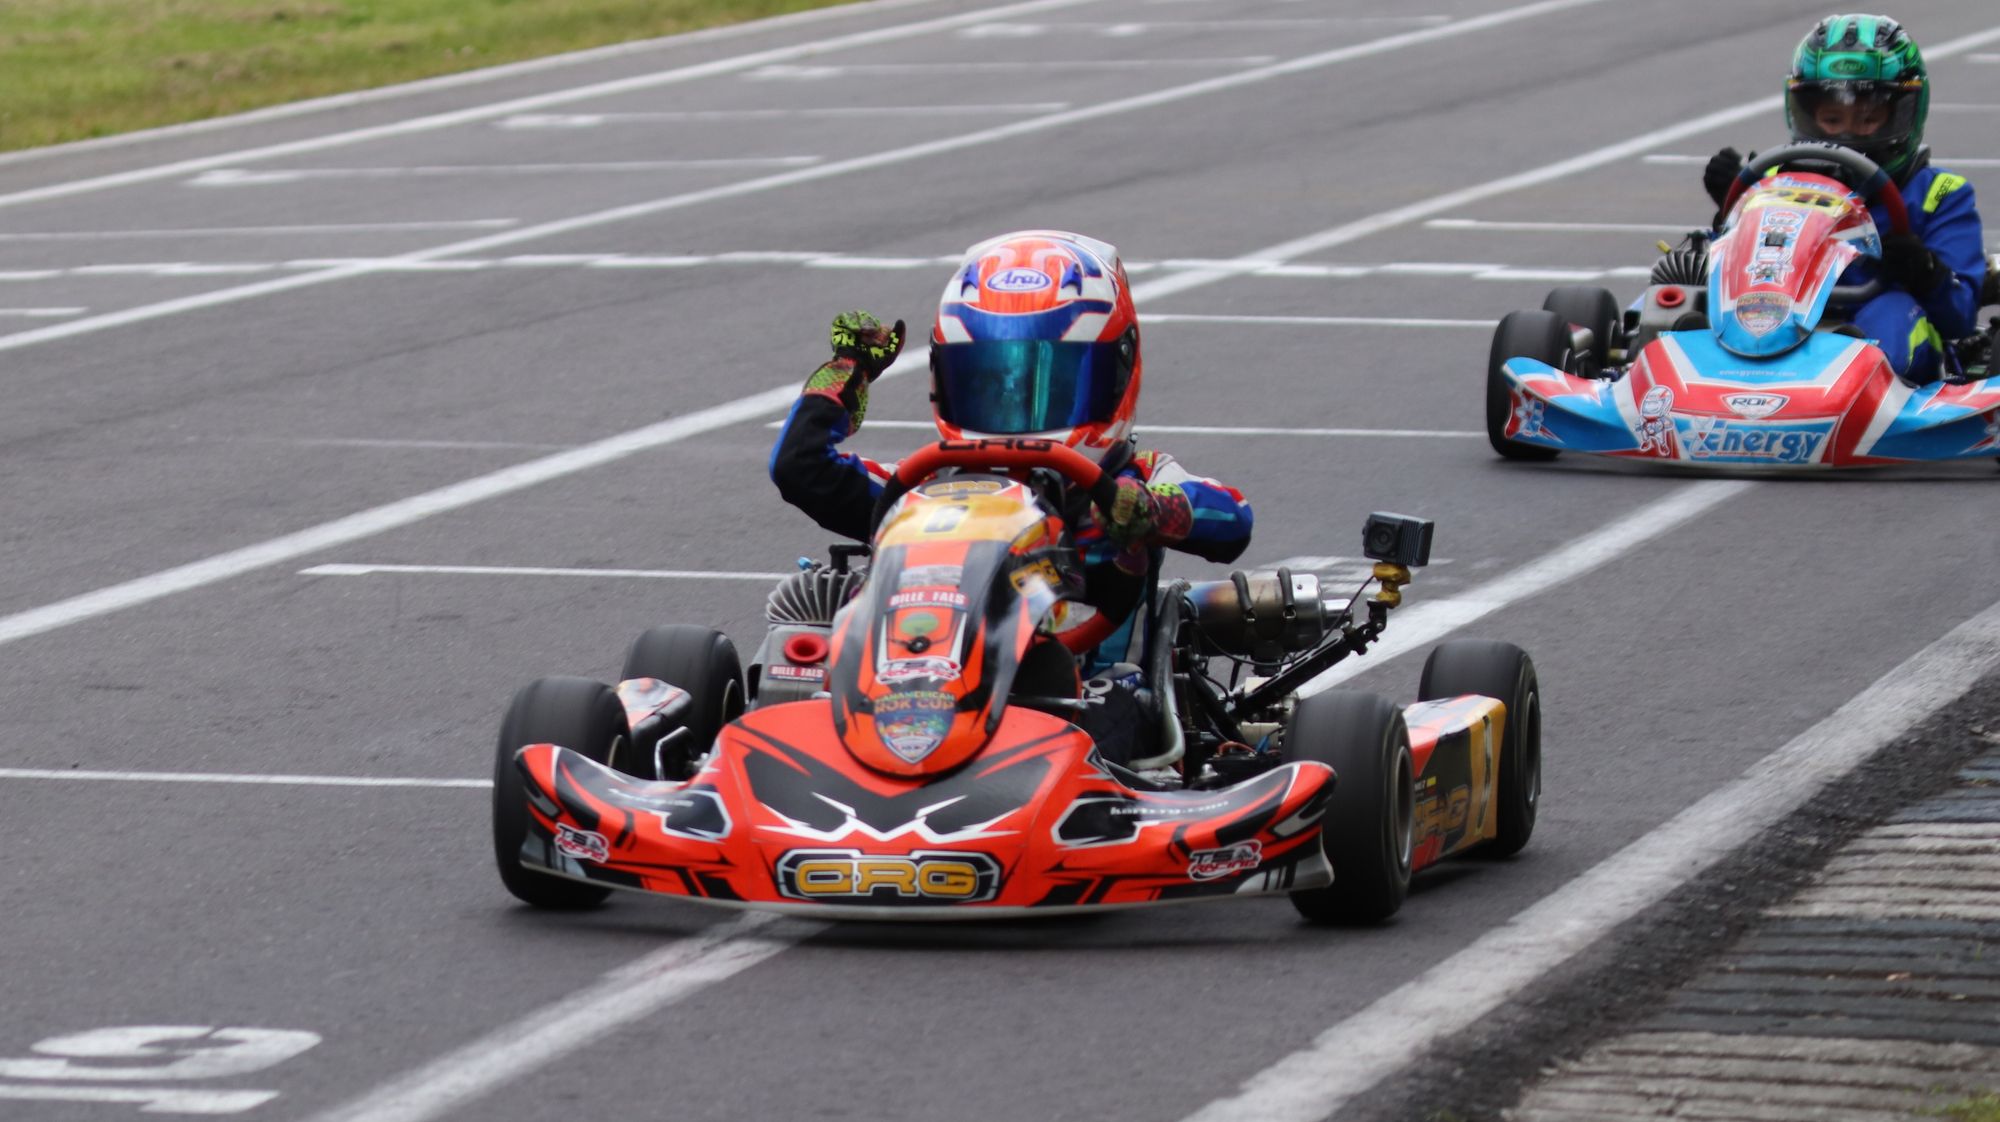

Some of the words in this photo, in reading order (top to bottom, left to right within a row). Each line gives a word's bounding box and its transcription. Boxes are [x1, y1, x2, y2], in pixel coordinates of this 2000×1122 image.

[1001, 271, 1041, 285] Arai
[1731, 398, 1775, 406] ROK
[1699, 420, 1826, 461] Energy
[794, 860, 979, 898] CRG
